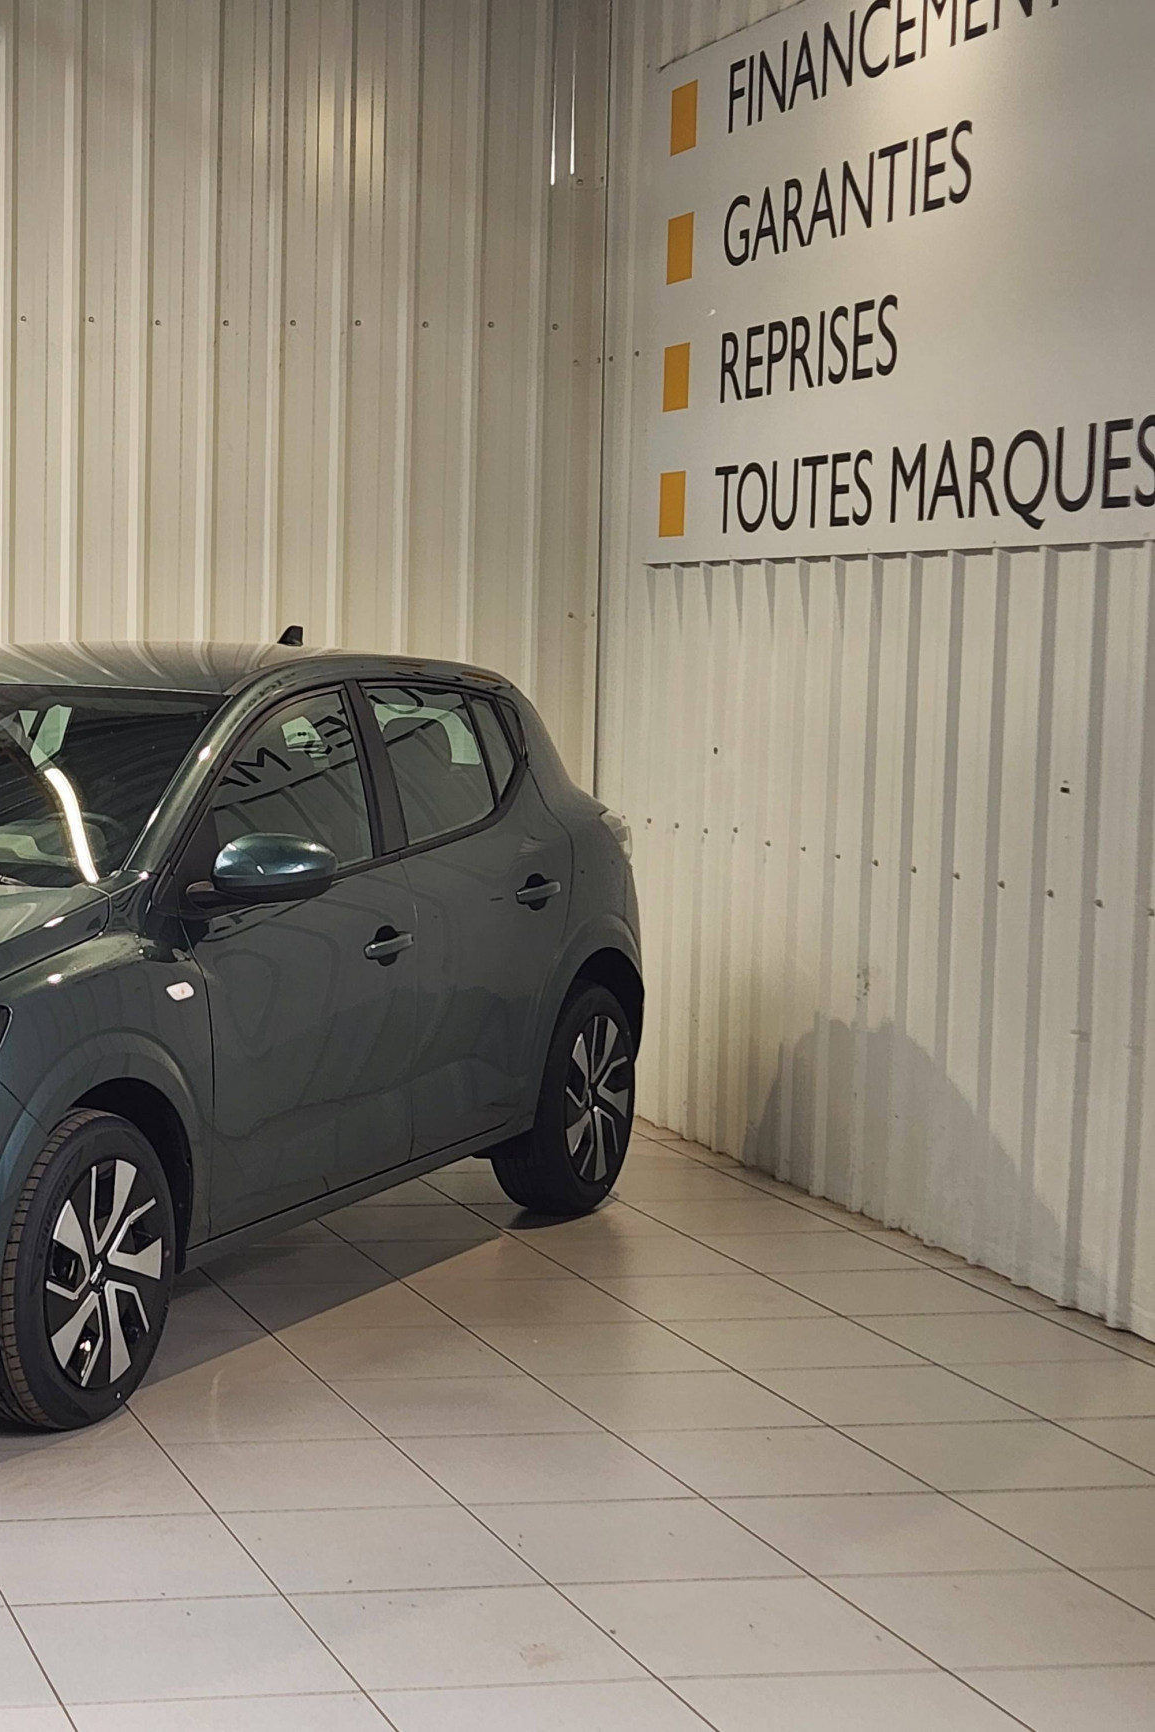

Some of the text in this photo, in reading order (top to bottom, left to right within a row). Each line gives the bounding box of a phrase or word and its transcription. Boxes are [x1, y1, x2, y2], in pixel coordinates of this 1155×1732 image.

[727, 0, 1059, 134] FINANCEME
[723, 120, 973, 267] GARANTIES
[719, 294, 898, 404] REPRISES
[714, 414, 1155, 534] TOUTES MARQUES
